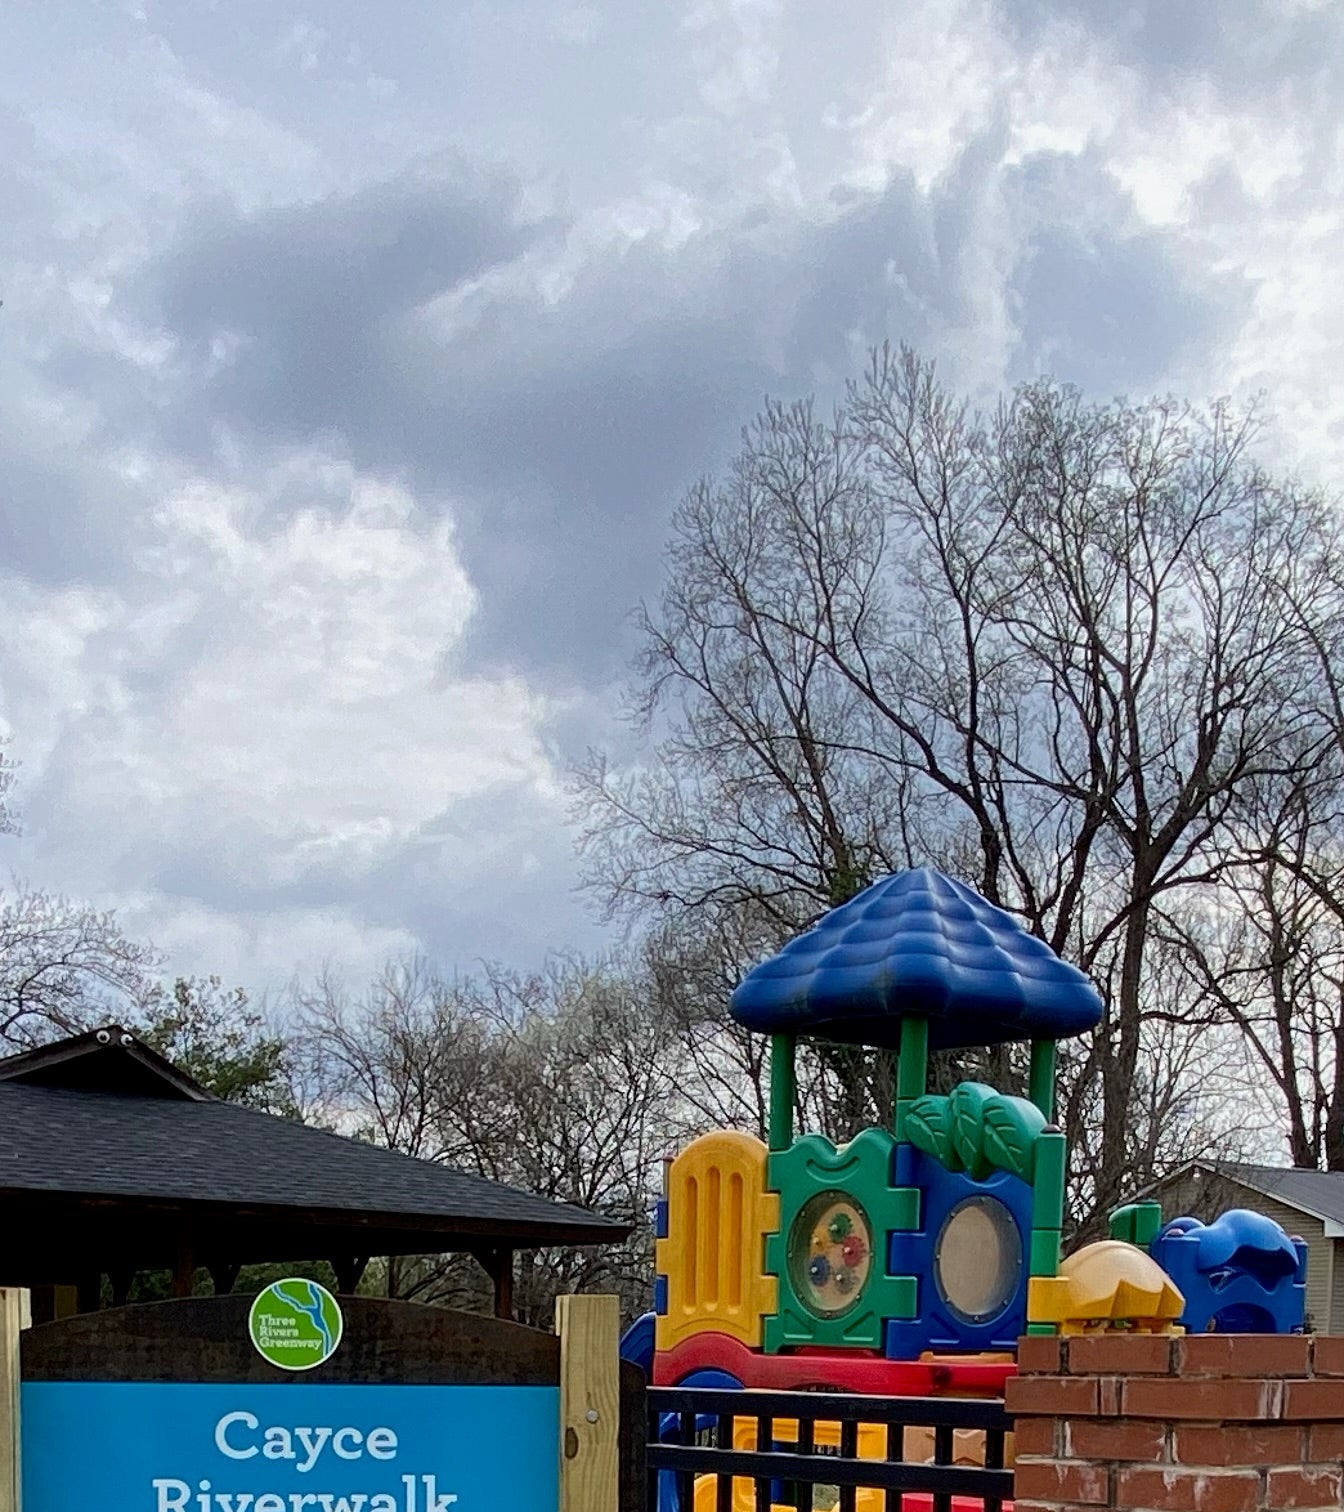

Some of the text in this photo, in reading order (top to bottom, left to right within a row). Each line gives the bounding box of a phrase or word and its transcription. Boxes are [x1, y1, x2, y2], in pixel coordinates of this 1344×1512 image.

[259, 1314, 296, 1326] Three
[259, 1326, 299, 1337] Rivers
[259, 1337, 322, 1350] Greenway
[214, 1411, 398, 1472] Cayce
